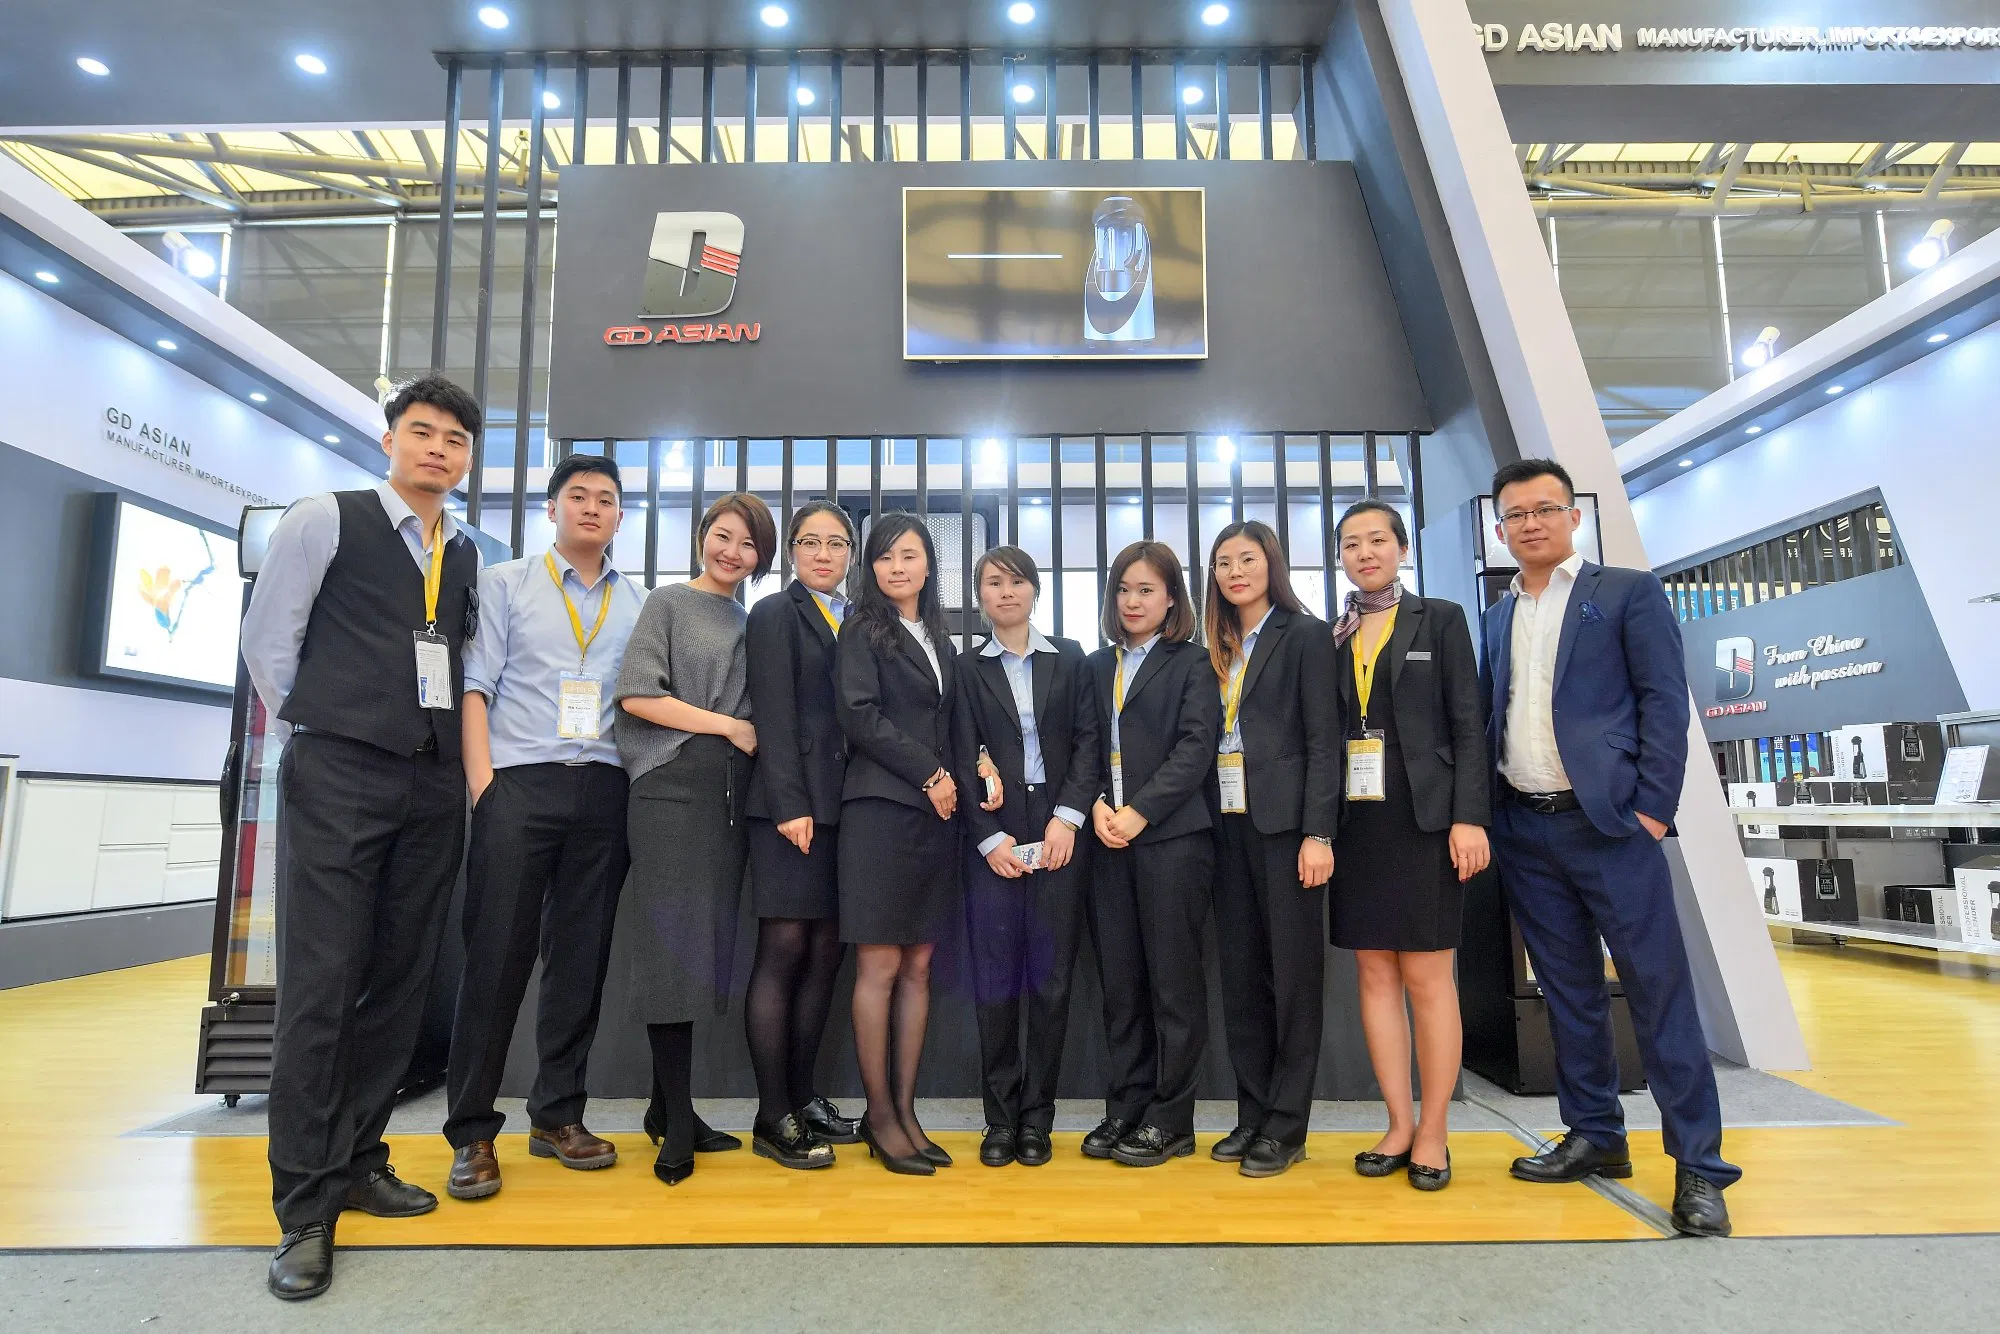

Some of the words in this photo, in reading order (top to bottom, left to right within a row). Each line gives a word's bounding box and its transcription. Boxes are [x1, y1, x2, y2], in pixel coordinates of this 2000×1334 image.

[1517, 22, 1623, 51] ASIAN
[604, 326, 652, 345] GD
[654, 323, 761, 343] ASIAN
[106, 407, 132, 430] GD
[139, 423, 191, 457] ASIAN
[1763, 645, 1808, 666] From
[1807, 634, 1865, 657] China
[1774, 664, 1811, 689] with
[1724, 700, 1767, 716] ASIAN
[1960, 875, 1973, 937] PROFESSIONAL
